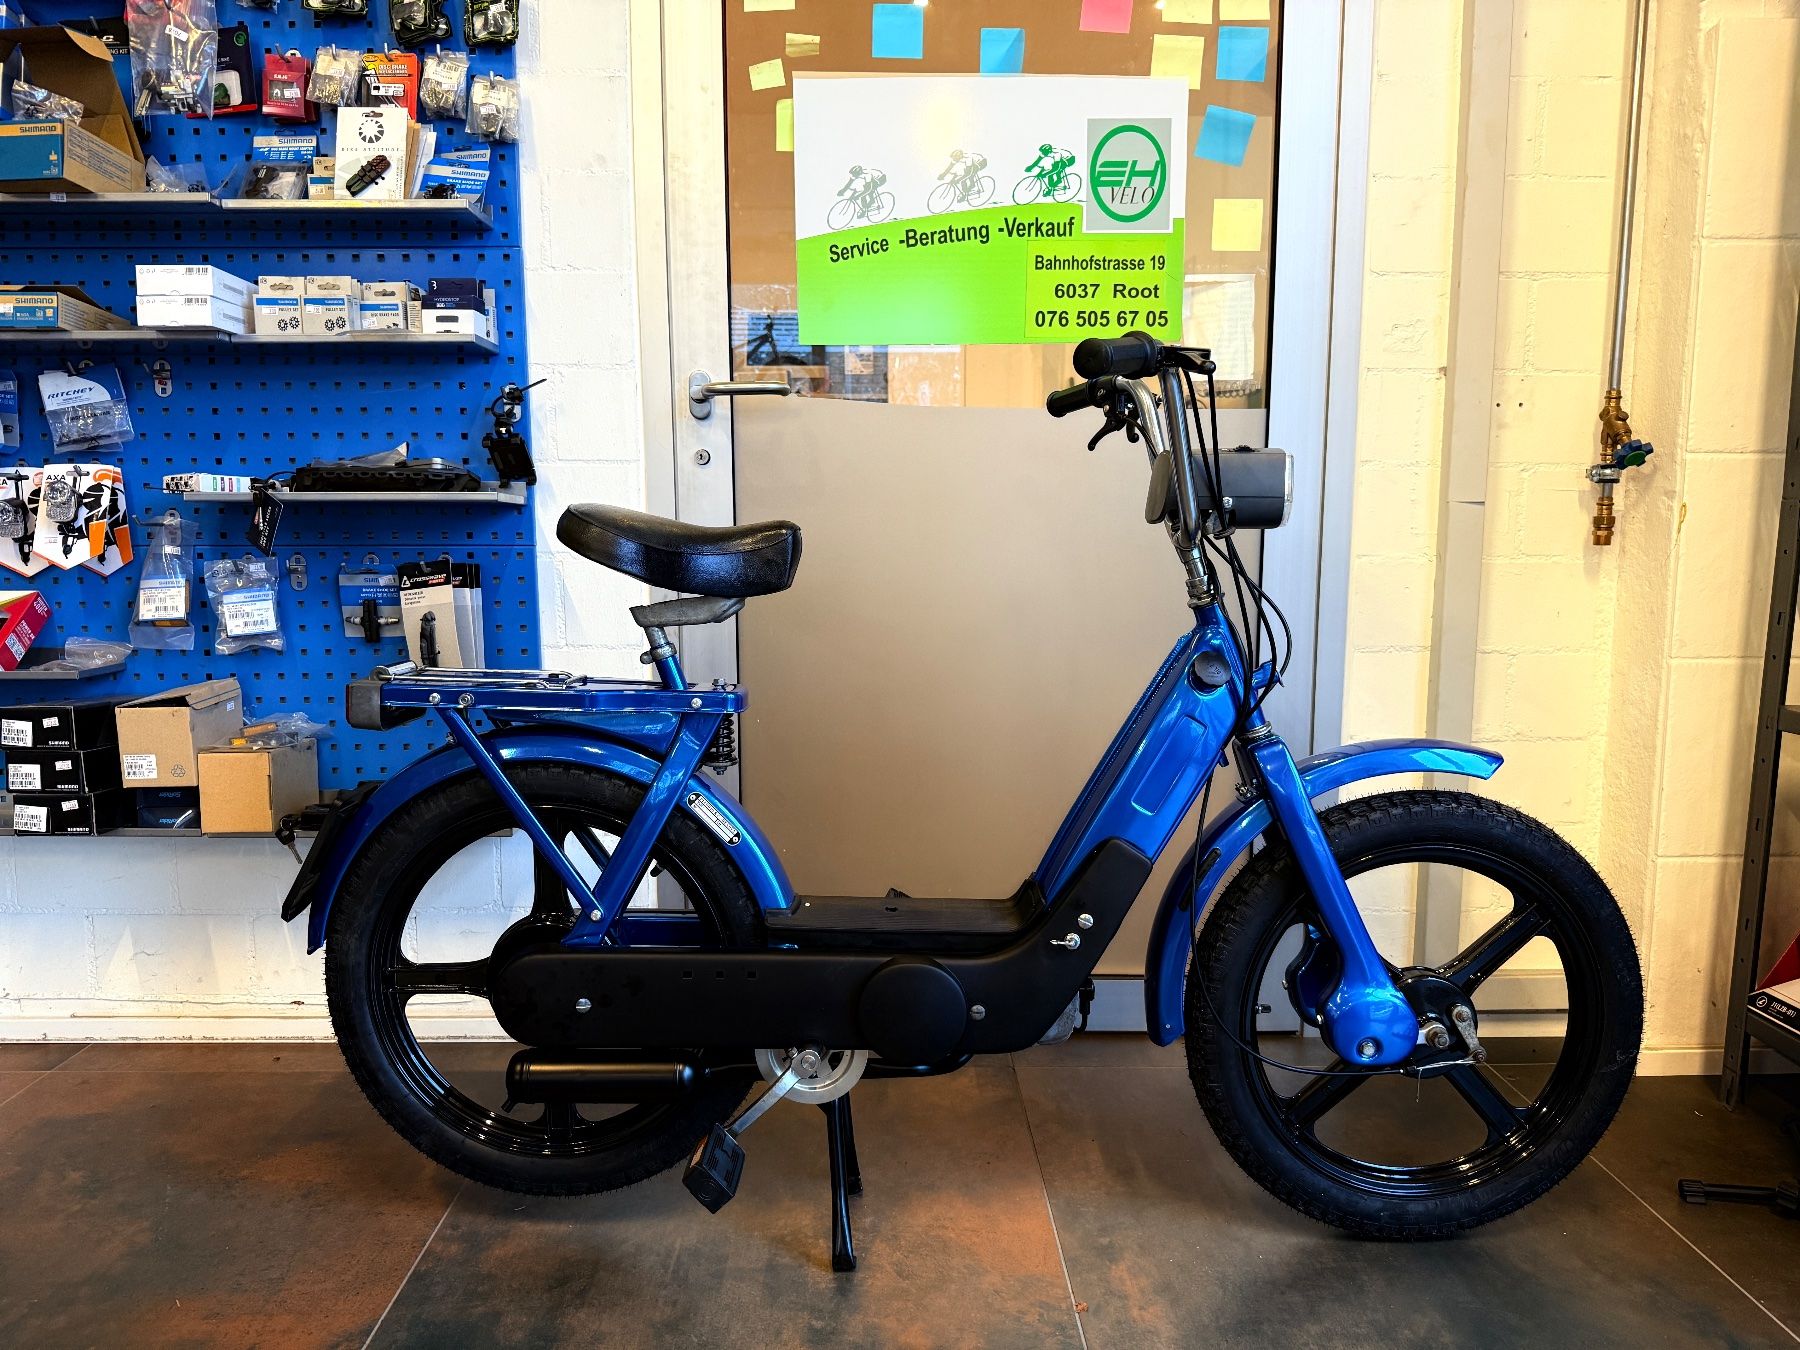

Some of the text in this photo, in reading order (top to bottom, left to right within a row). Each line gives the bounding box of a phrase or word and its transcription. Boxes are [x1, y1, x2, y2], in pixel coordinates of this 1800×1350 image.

[19, 125, 57, 133] SHIMANO
[455, 152, 487, 160] SHIMANO
[450, 169, 487, 178] SHIMANO
[1110, 186, 1155, 205] VELO
[829, 216, 1076, 263] Service -Beratung -Verkauf
[1034, 254, 1166, 271] Bahnhofstrasse 19
[1054, 283, 1160, 300] 6037 Root
[1034, 310, 1169, 328] 076 505 67 05
[47, 386, 96, 400] RITCHEY
